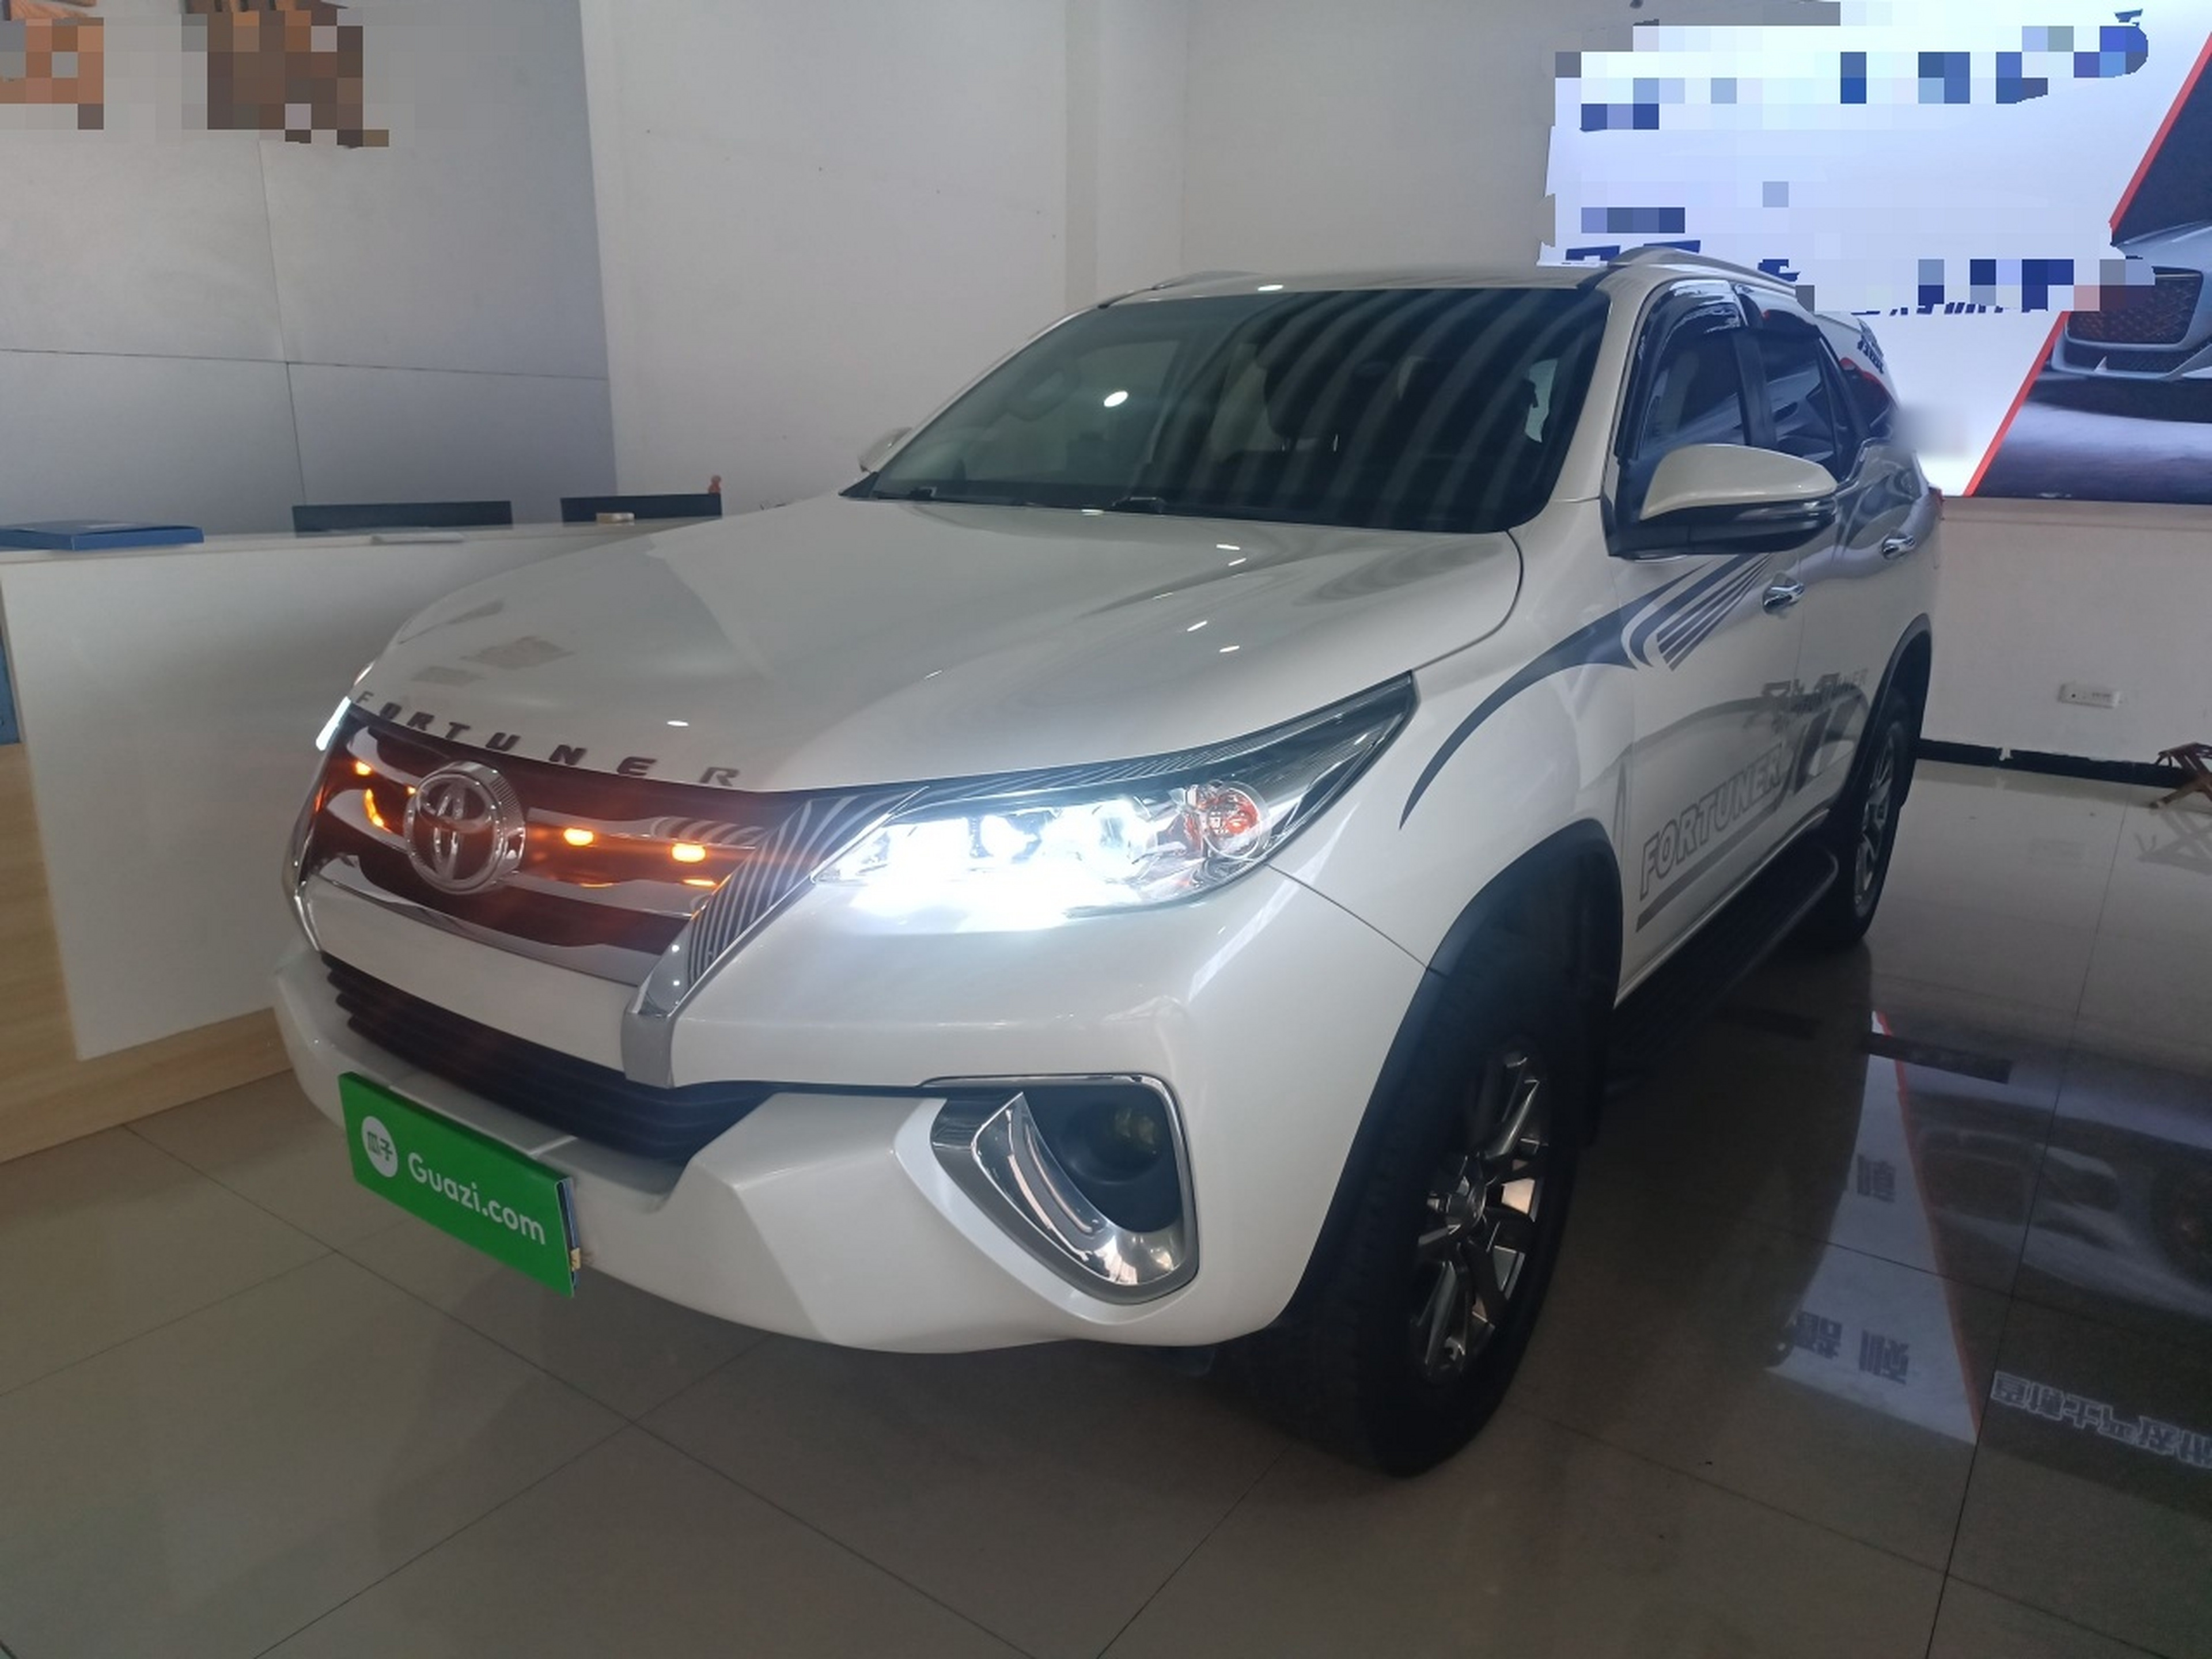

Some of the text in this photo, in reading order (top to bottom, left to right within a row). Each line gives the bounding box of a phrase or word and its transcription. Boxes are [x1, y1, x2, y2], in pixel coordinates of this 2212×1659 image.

[355, 691, 740, 787] FORTUNER
[1640, 743, 1788, 901] FORTUNER
[408, 1152, 545, 1245] Guazi.com
